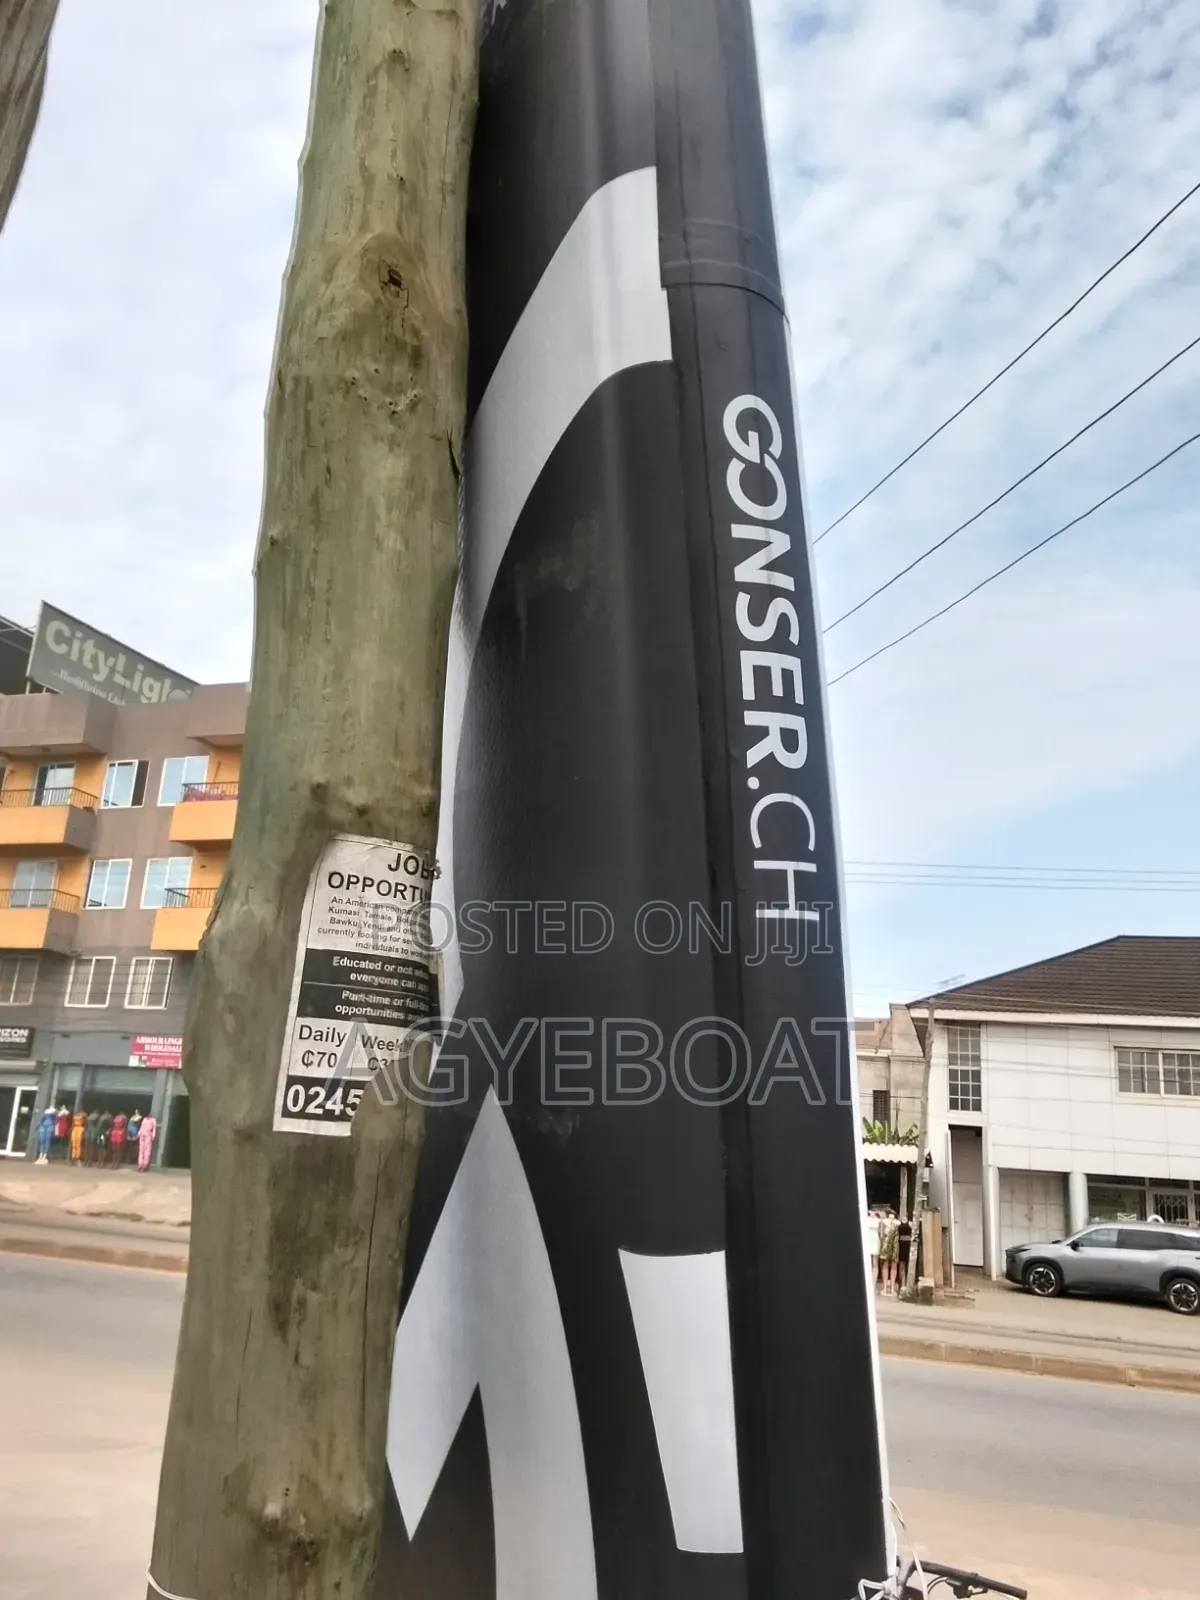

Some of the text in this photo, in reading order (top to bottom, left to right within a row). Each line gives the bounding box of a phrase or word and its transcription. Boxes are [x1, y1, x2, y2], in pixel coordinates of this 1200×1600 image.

[330, 896, 343, 905] An
[345, 897, 384, 911] American
[317, 927, 356, 938] currently
[389, 935, 401, 943] for
[355, 941, 399, 953] individuals
[401, 947, 409, 955] to
[333, 956, 382, 970] Educated
[383, 963, 396, 972] or
[350, 972, 399, 986] everyone
[401, 978, 417, 989] can
[393, 998, 404, 1006] or
[335, 1004, 405, 1020] opportunities
[298, 1024, 347, 1048] Daily
[286, 1084, 365, 1116] 0245
